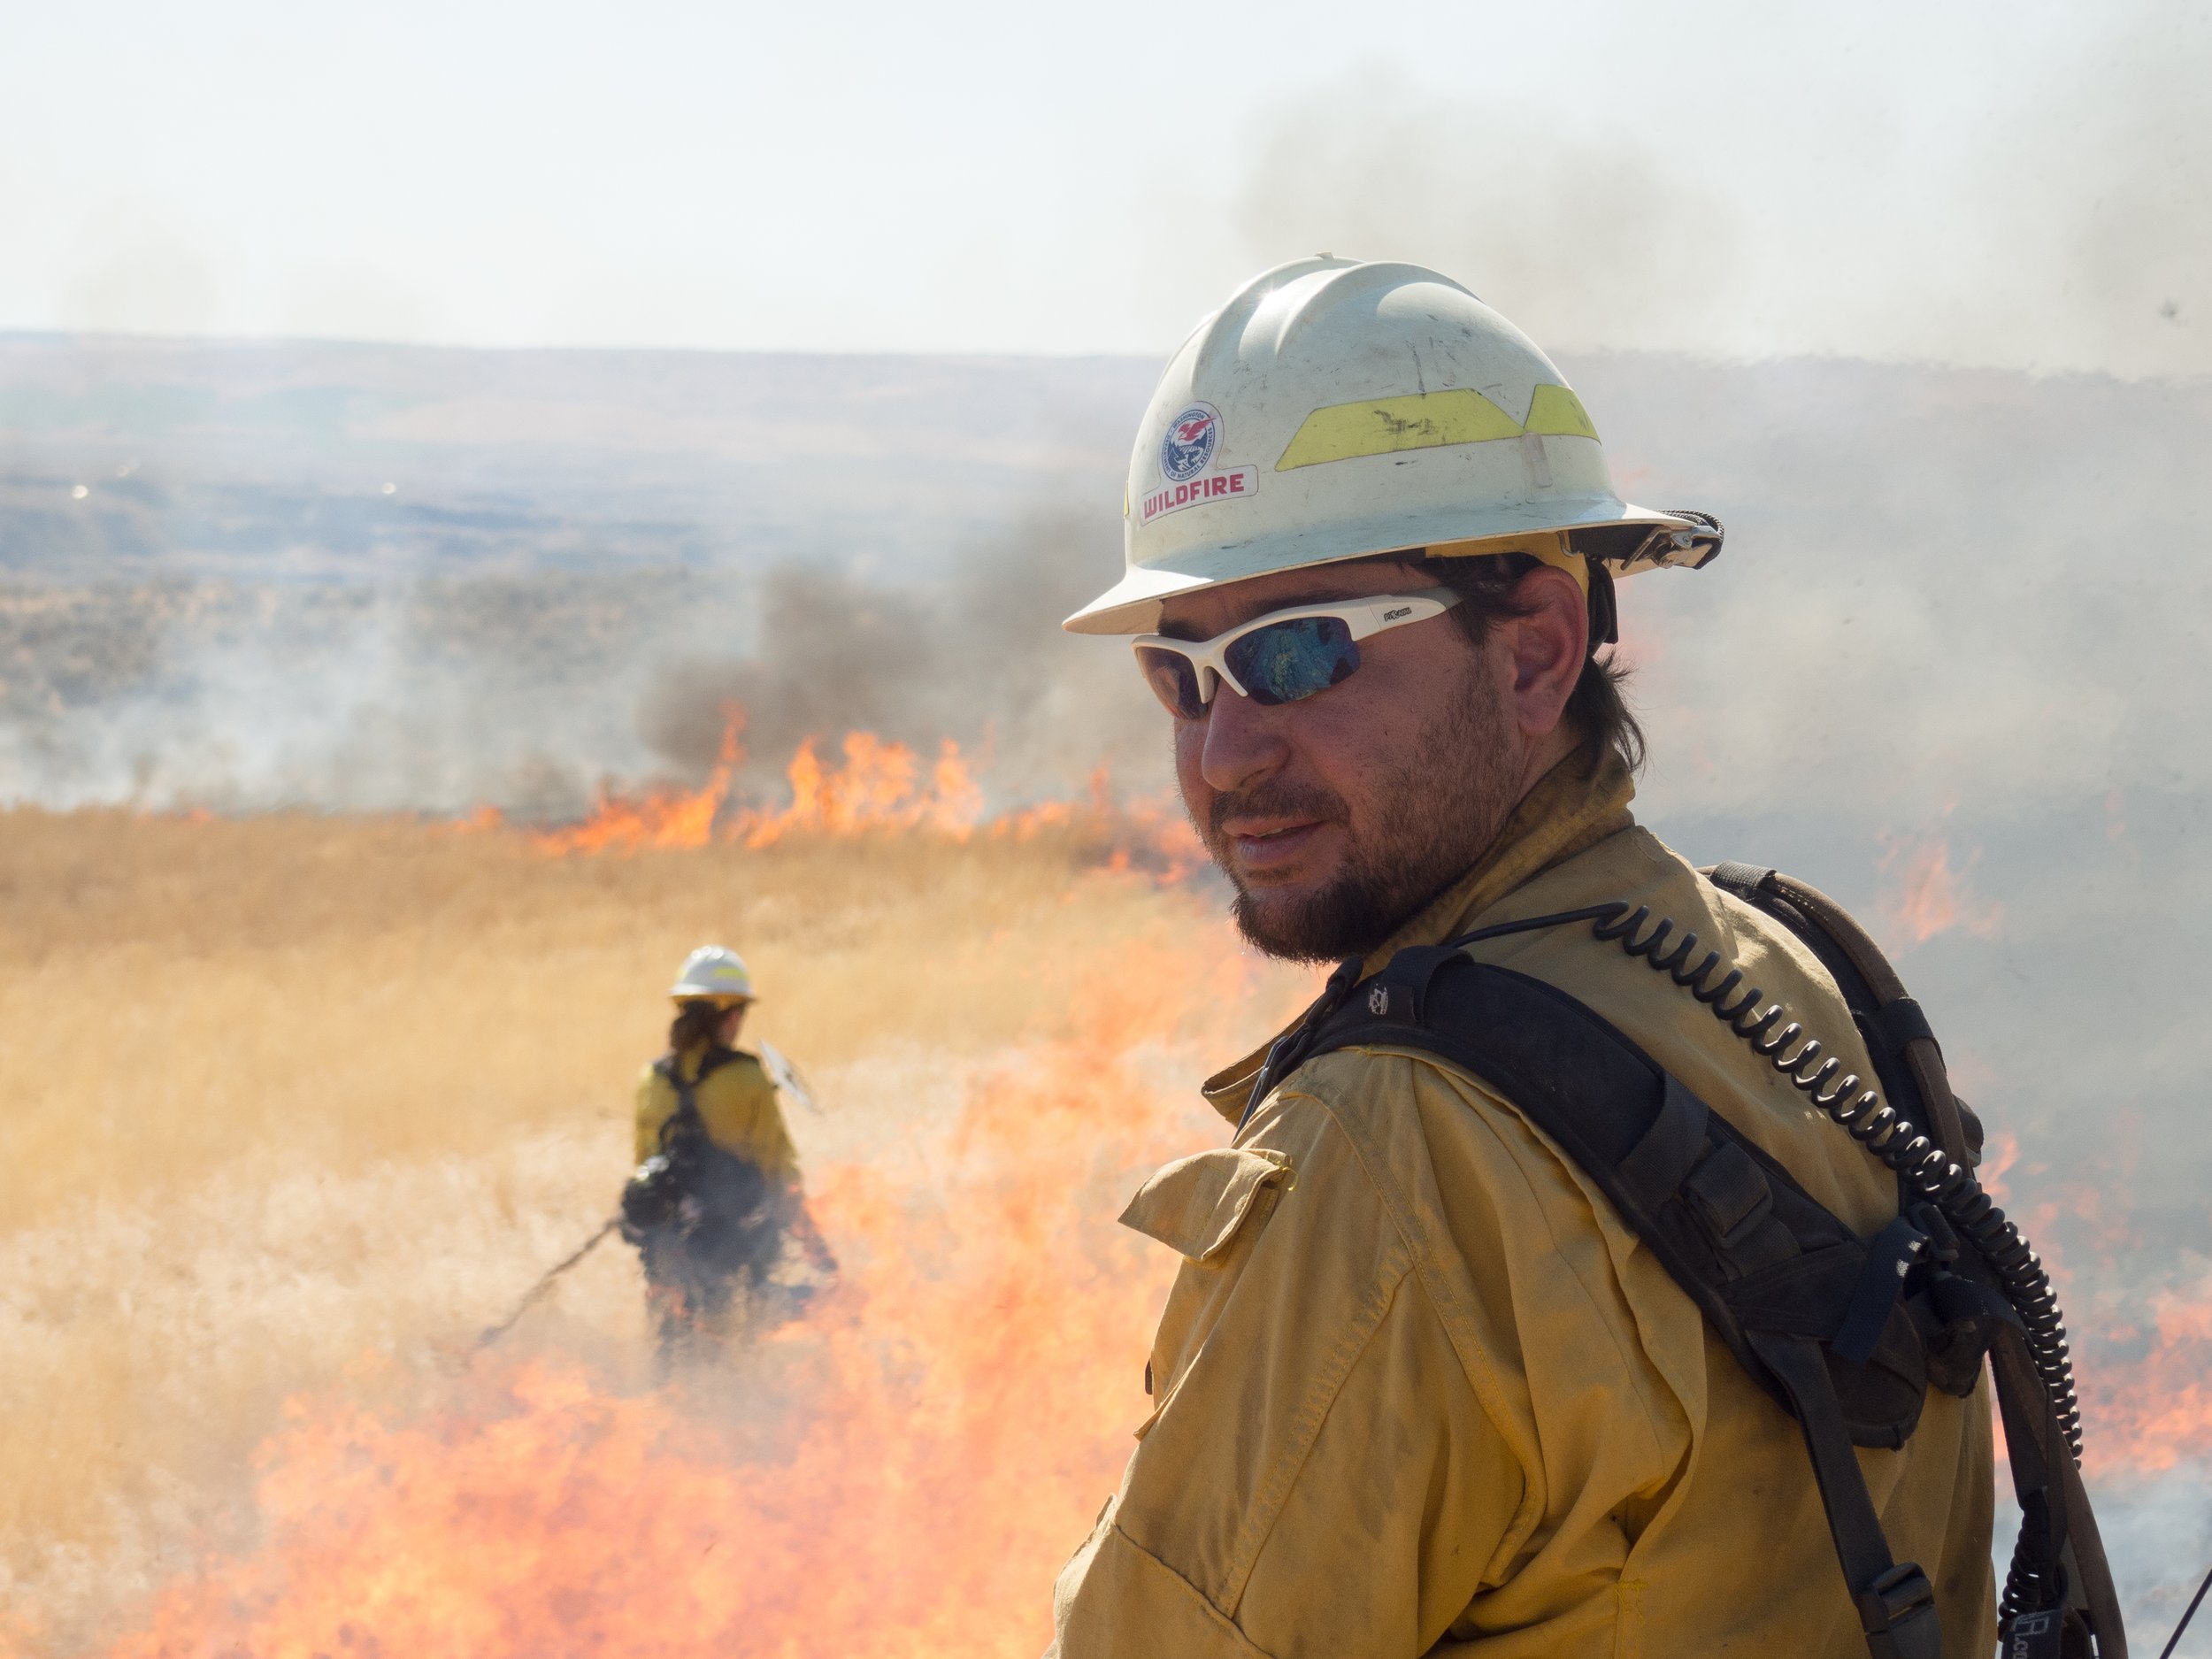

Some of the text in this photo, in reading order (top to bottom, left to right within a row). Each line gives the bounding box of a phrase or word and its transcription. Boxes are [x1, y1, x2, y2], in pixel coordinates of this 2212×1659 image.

[1172, 411, 1205, 429] WASHINGTON
[1162, 434, 1171, 473] DEPARTMENT
[1177, 465, 1201, 479] NATURAL
[1201, 426, 1213, 465] RESOURCES
[1144, 473, 1245, 519] WILDFIRE
